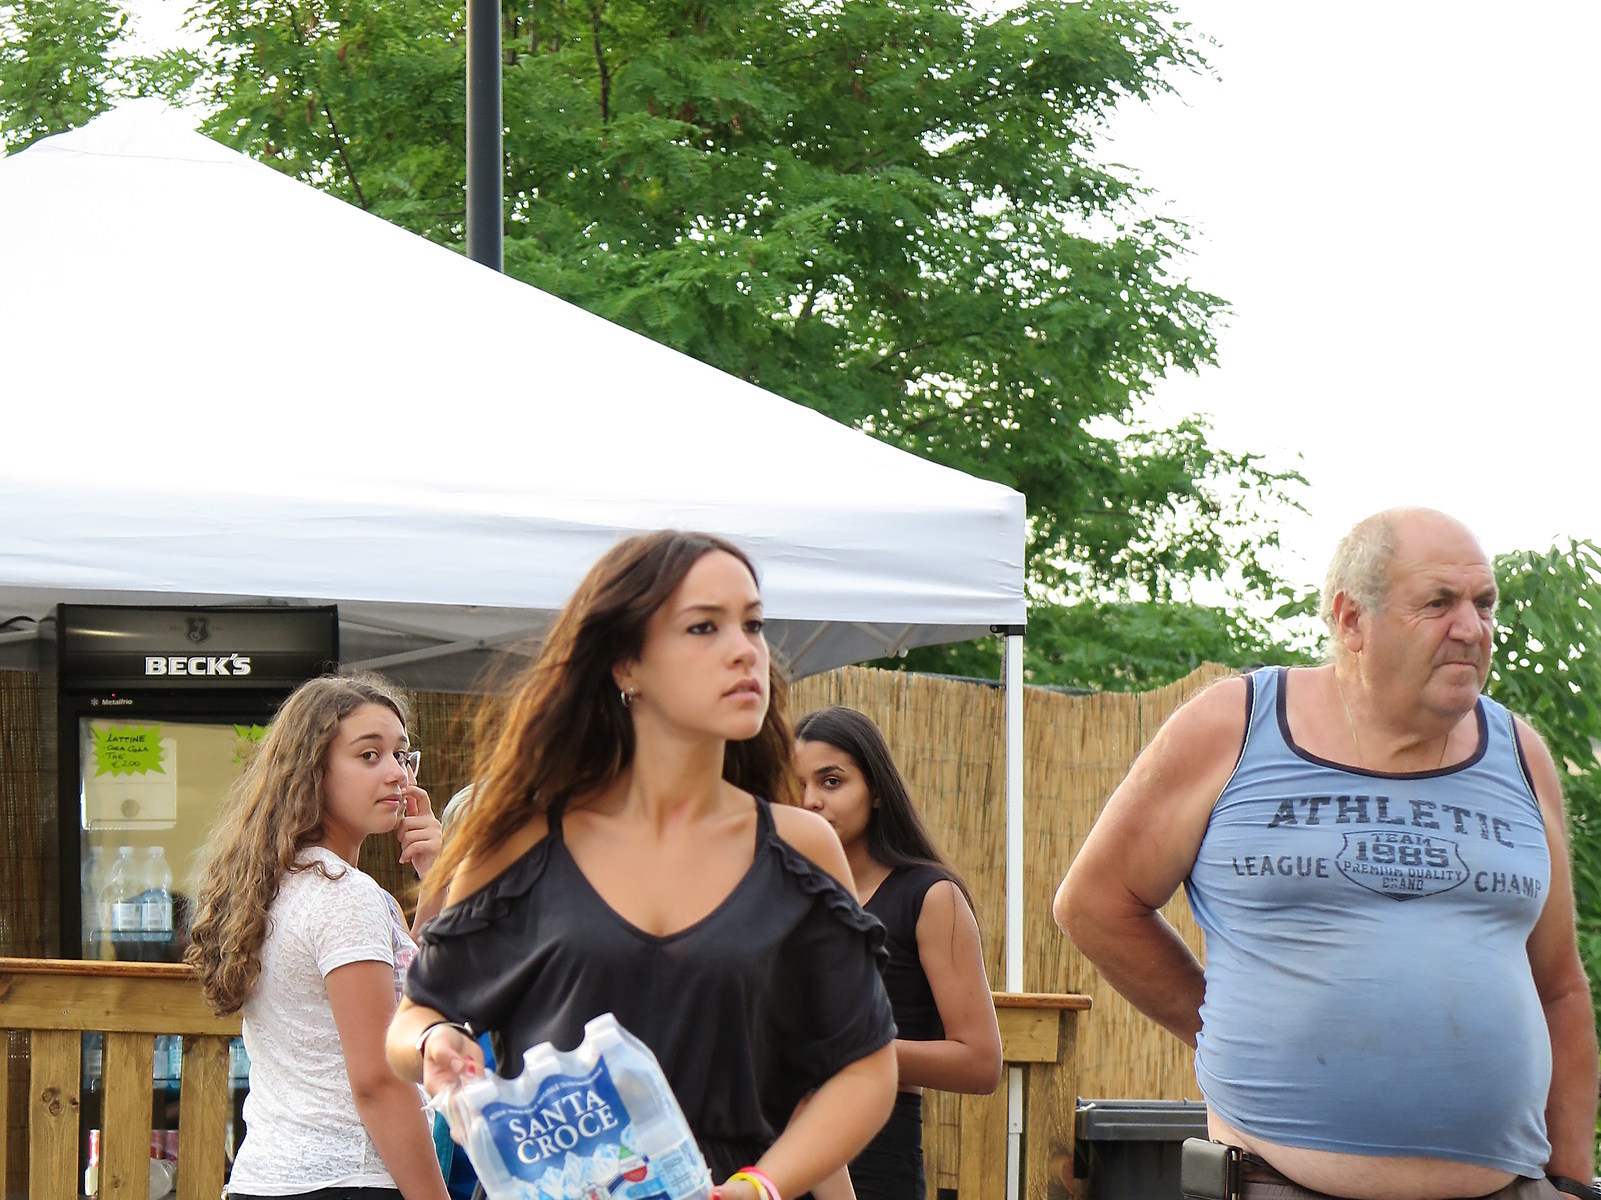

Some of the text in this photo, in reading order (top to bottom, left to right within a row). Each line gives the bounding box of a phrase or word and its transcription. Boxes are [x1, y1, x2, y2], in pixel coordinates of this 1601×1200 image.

[145, 653, 251, 676] BECK'S
[1267, 796, 1514, 849] ATHLETIC
[1371, 833, 1431, 848] TEAM
[1356, 841, 1449, 868] 1985
[1232, 856, 1329, 878] LEAGUE
[1343, 861, 1462, 881] PREMIUM QUALITY
[1382, 877, 1424, 891] BRAND
[508, 1090, 606, 1143] SANTA
[517, 1104, 619, 1165] CROCE
